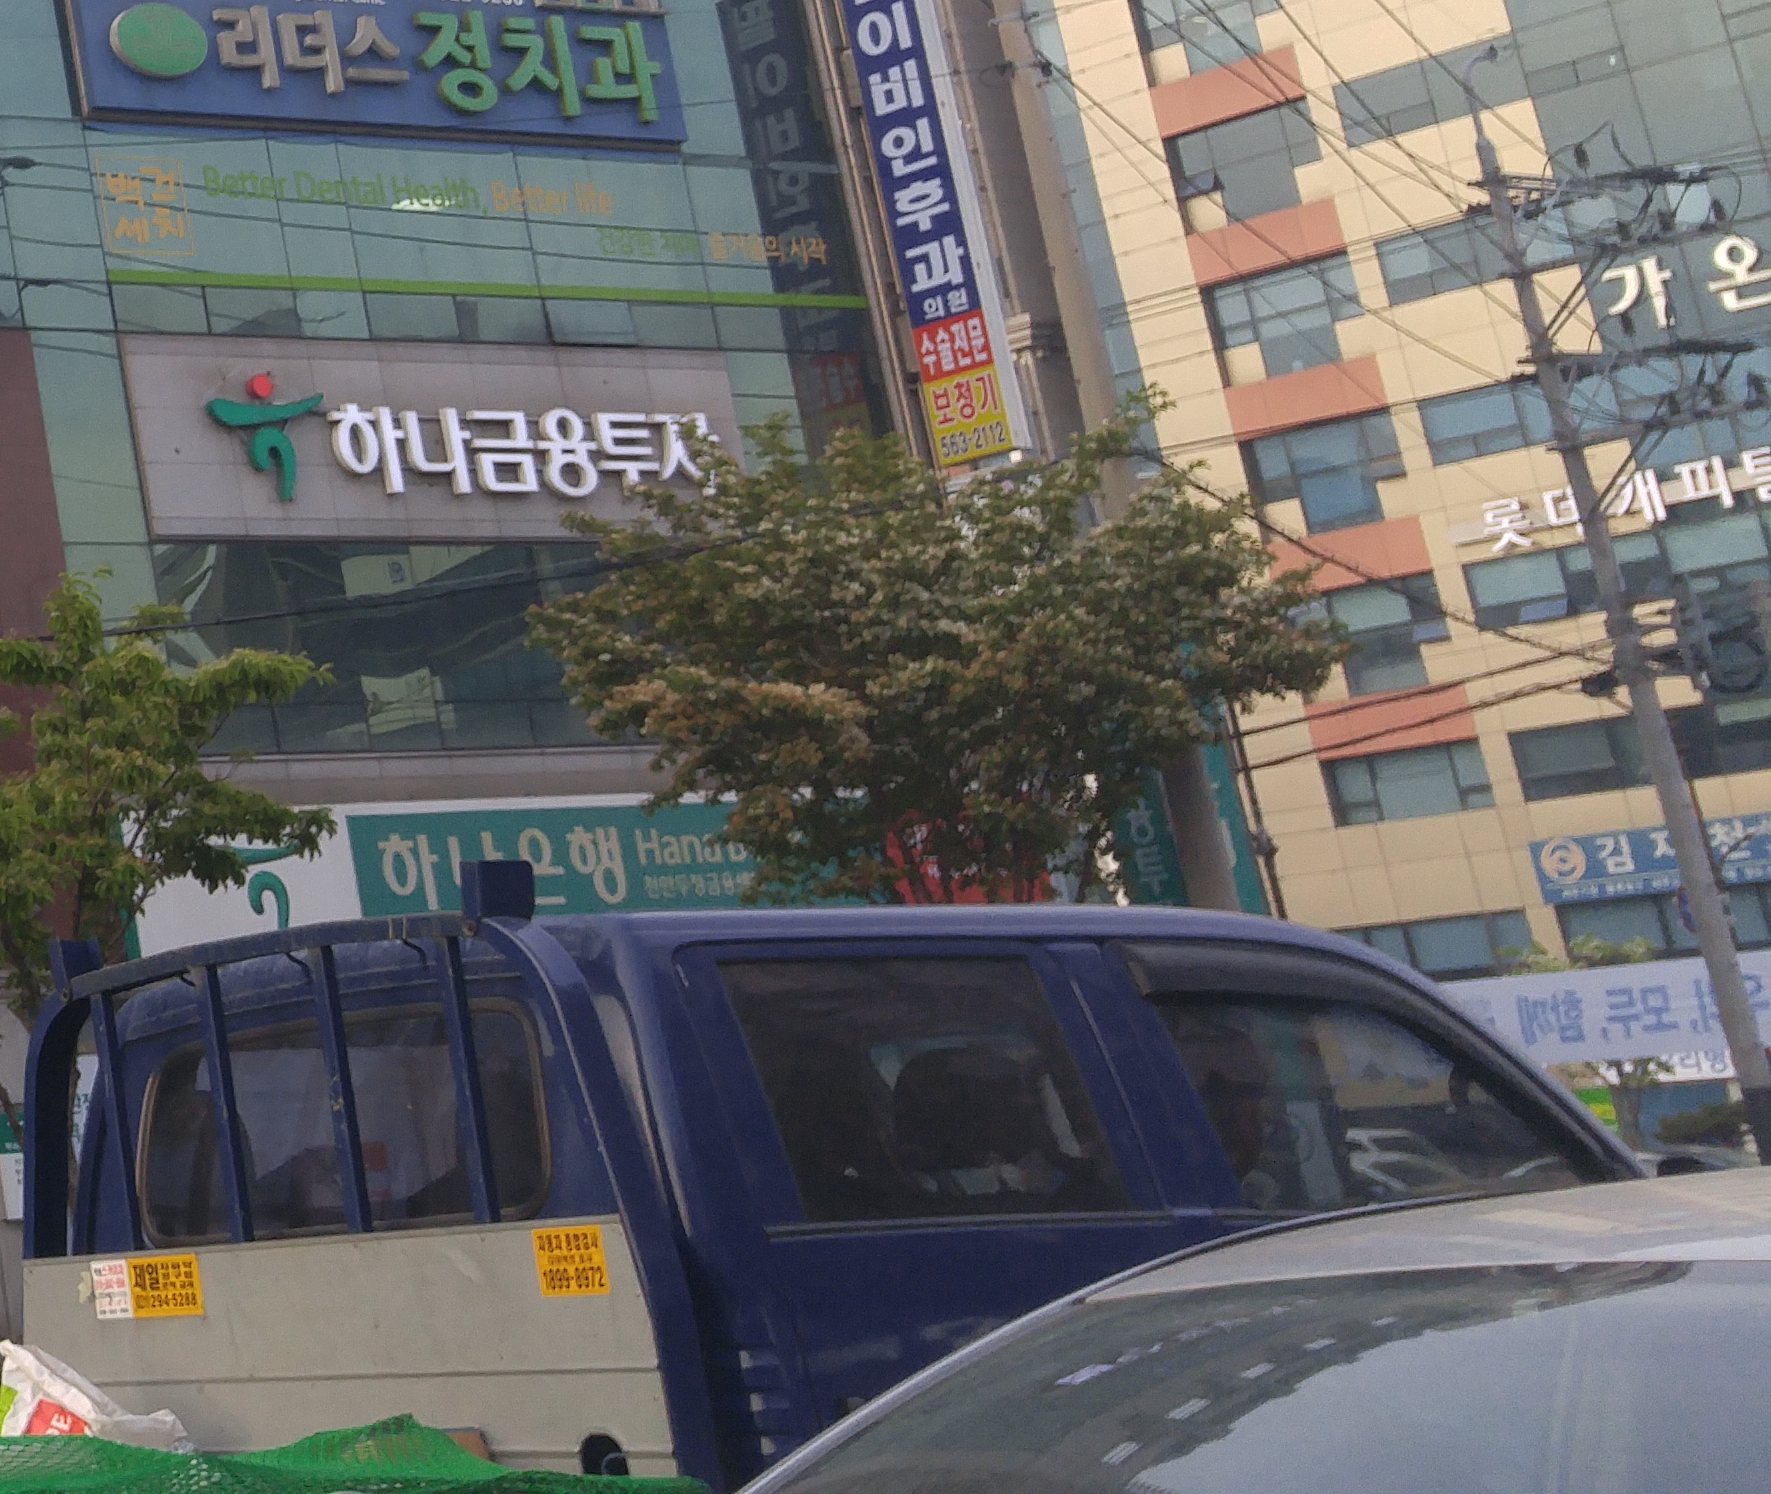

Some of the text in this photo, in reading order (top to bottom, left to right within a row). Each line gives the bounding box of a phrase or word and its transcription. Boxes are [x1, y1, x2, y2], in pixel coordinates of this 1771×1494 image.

[412, 9, 662, 123] 정치과
[202, 165, 287, 200] Better
[294, 170, 387, 206] Dental
[490, 181, 569, 215] Better
[920, 316, 989, 377] 수술전문
